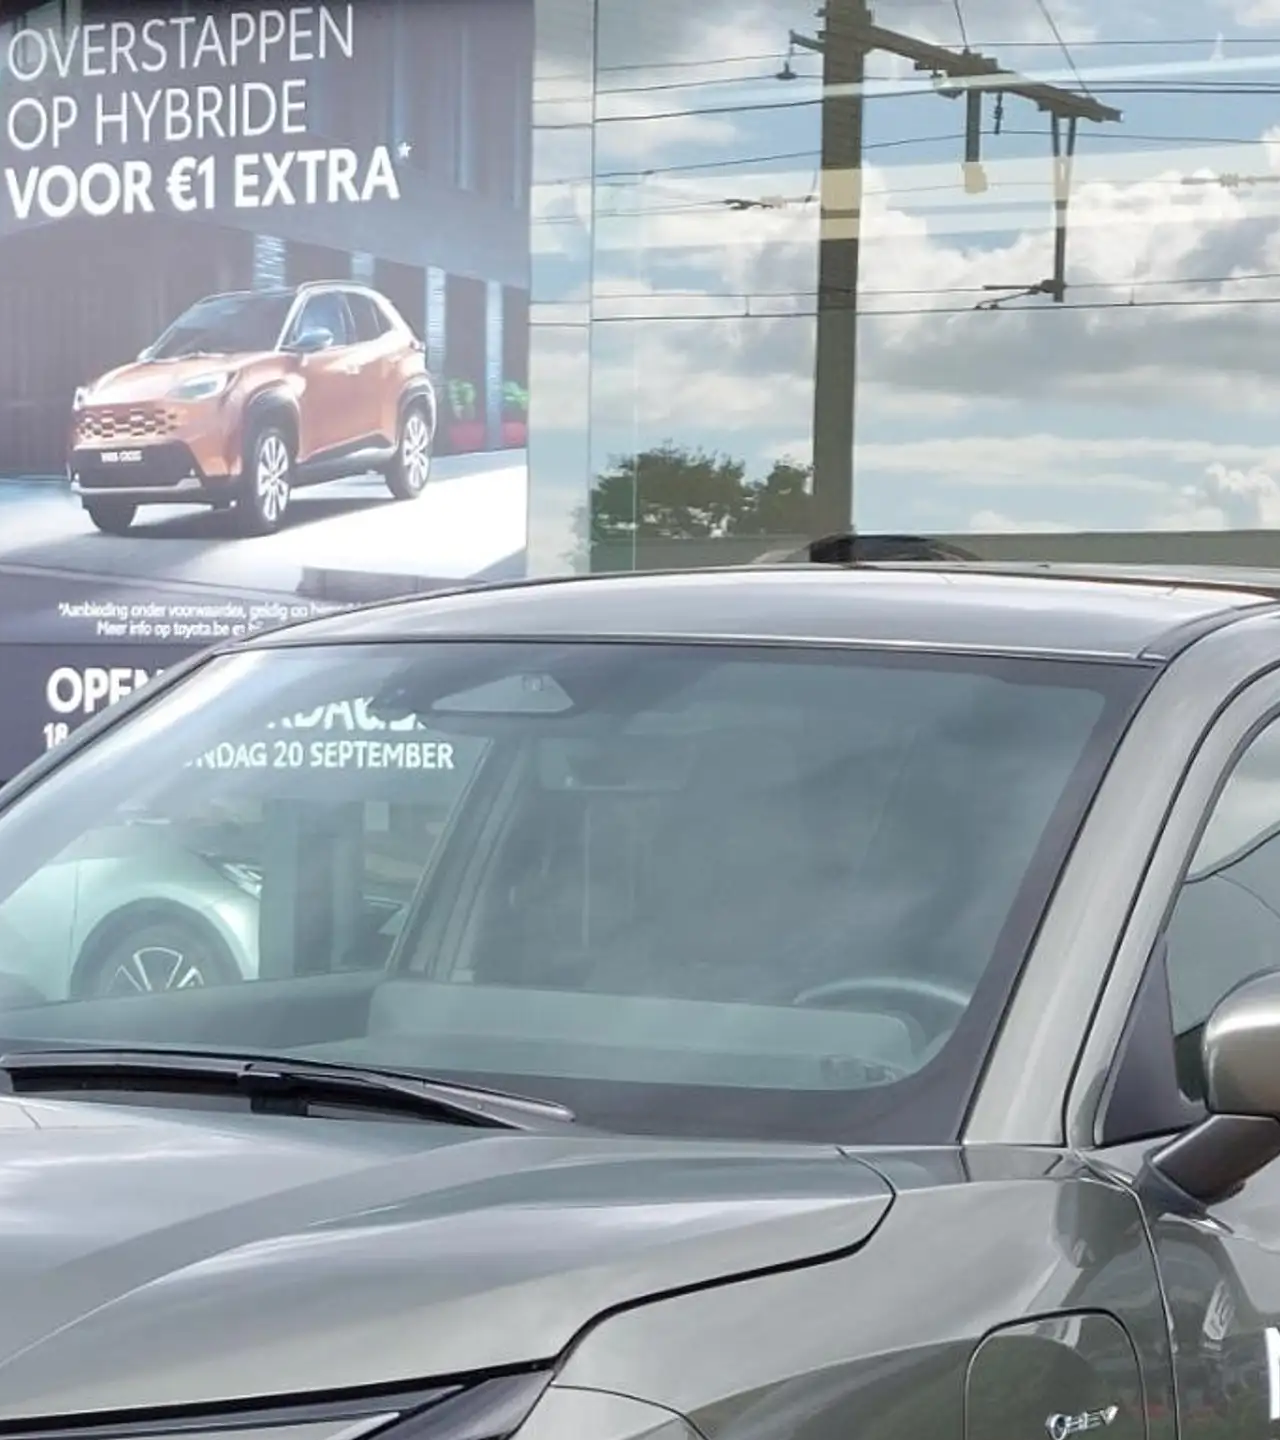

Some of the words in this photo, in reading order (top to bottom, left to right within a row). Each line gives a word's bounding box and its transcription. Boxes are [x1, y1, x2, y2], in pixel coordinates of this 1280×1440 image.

[8, 4, 353, 81] OVERSTAPPEN
[8, 97, 77, 150] OP
[96, 79, 306, 145] HYBRIDE
[5, 160, 156, 219] VOOR
[166, 155, 215, 212] €1
[183, 742, 268, 769] NDAG
[273, 740, 304, 768] 20
[310, 740, 455, 769] SEPTEMBER
